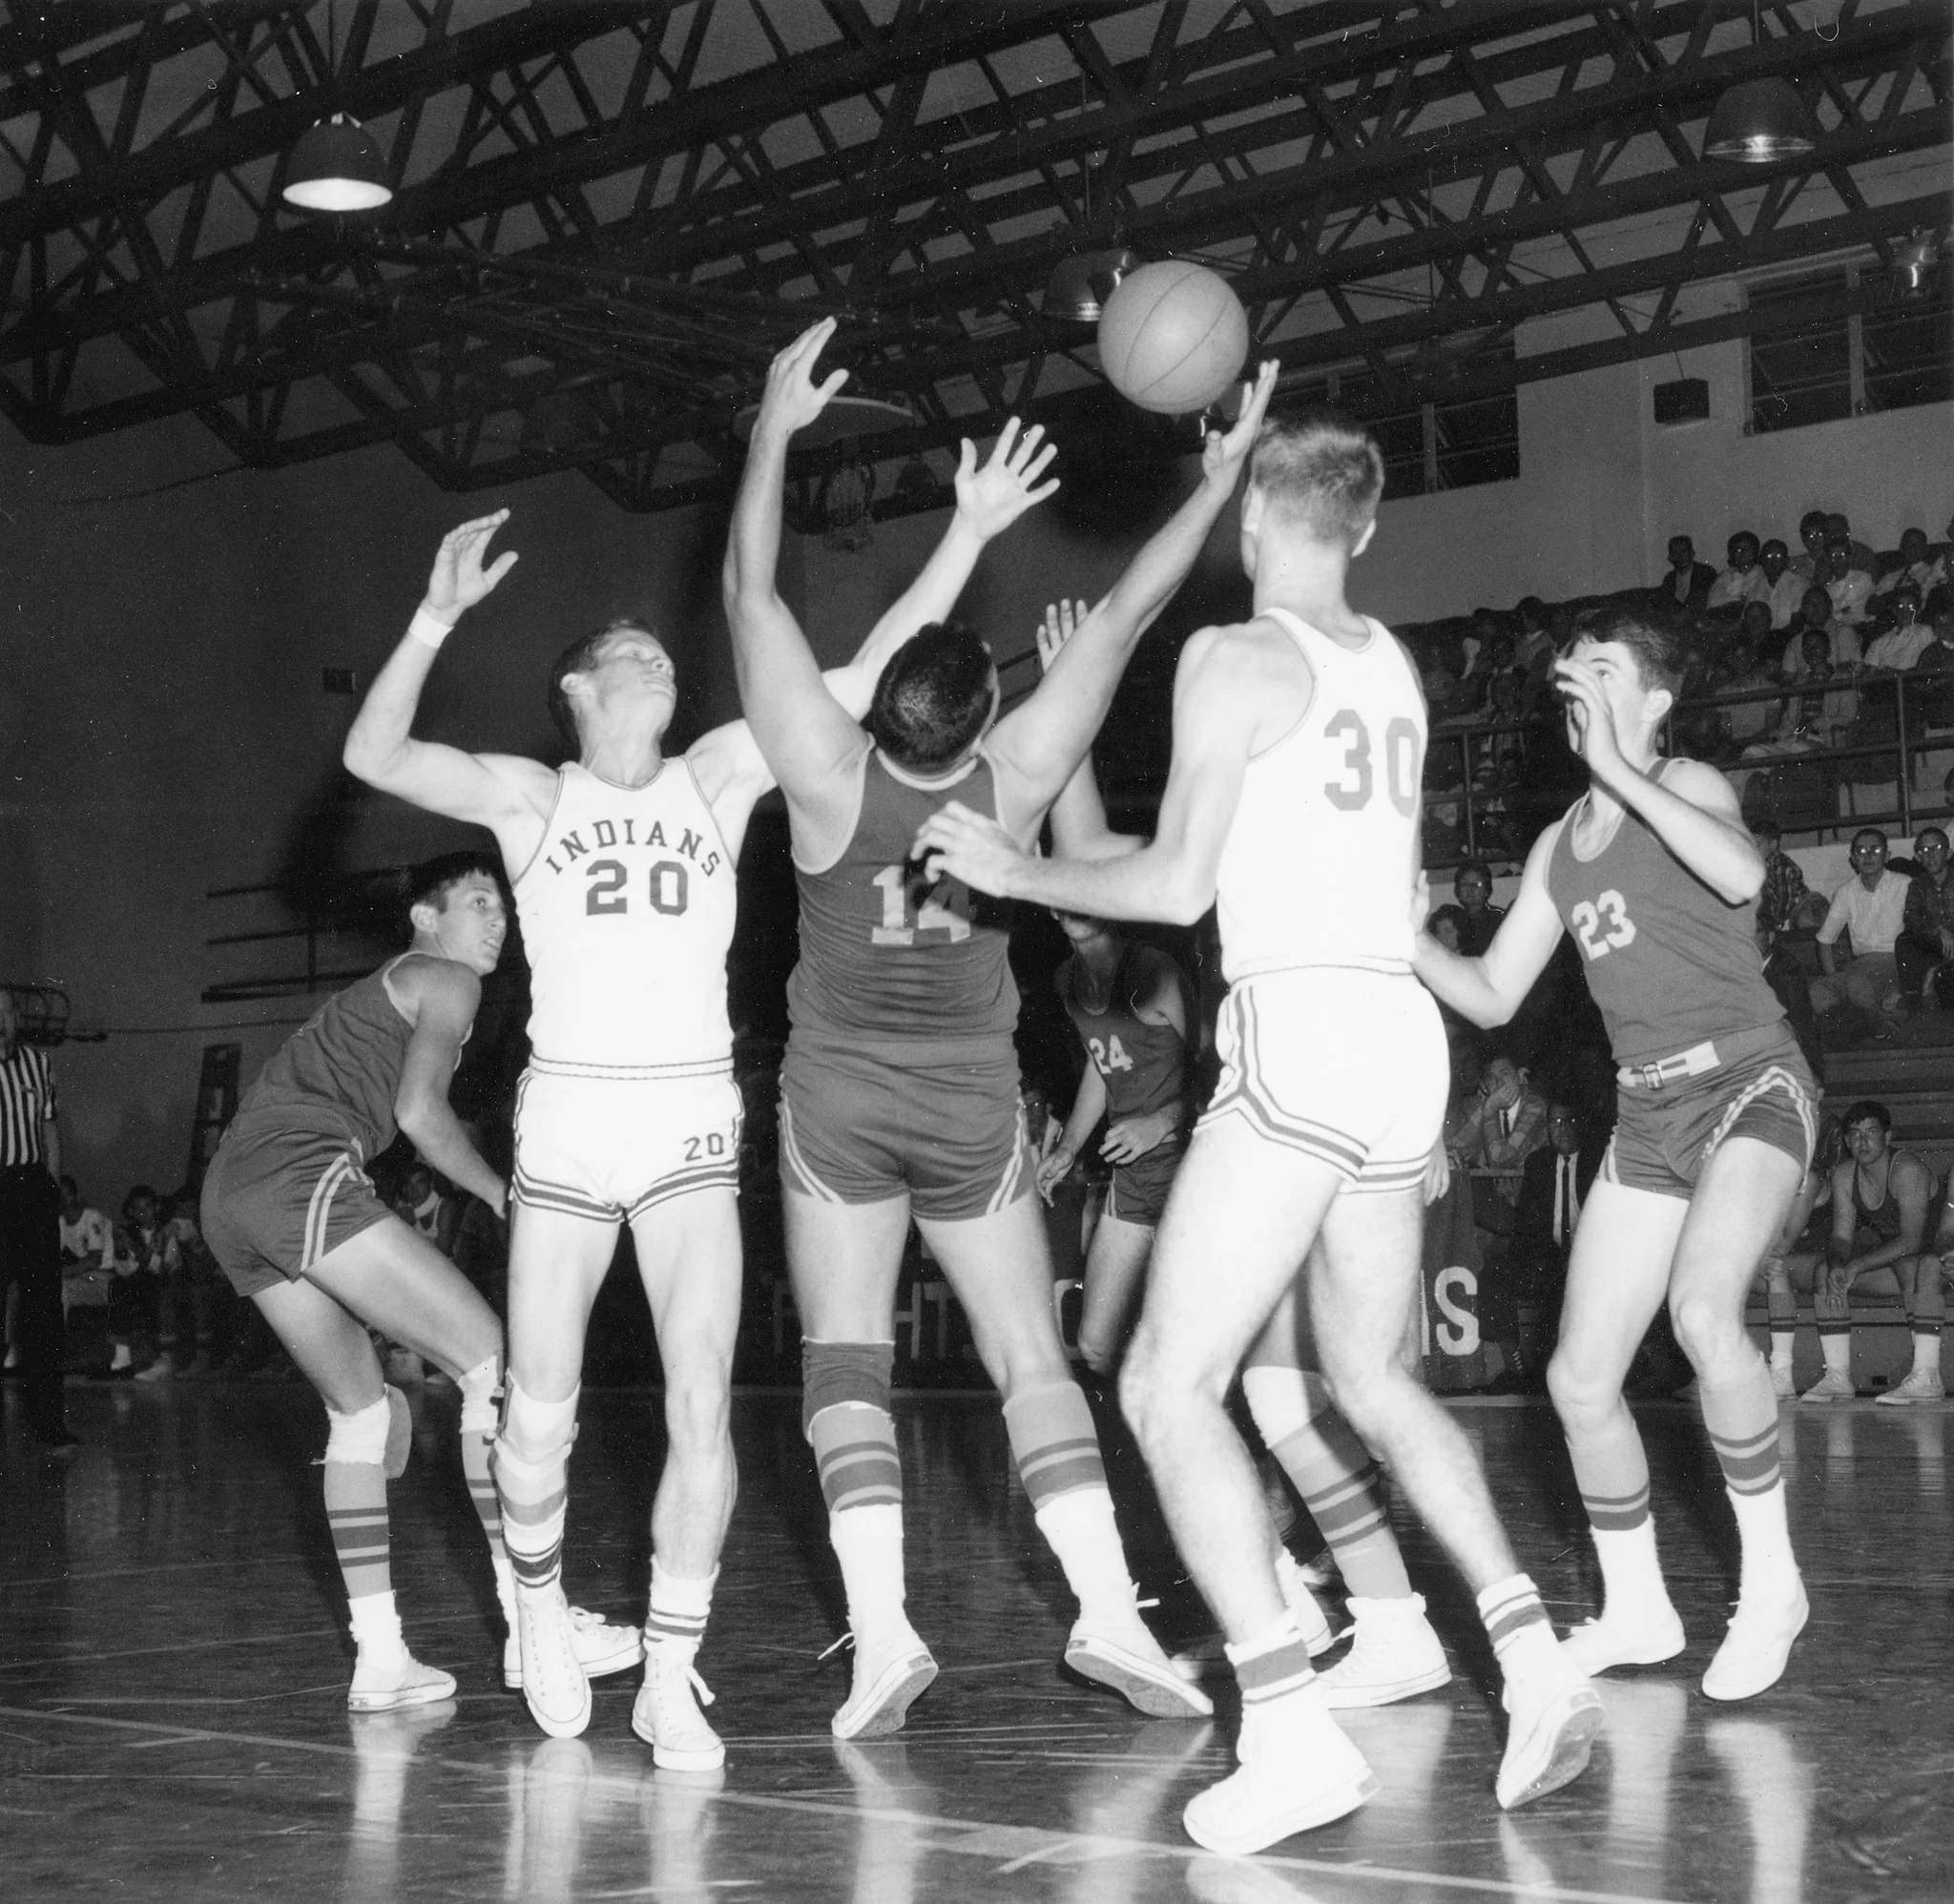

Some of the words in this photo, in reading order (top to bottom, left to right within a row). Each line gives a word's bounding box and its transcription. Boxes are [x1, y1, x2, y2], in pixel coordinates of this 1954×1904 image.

[1324, 709, 1421, 817] 30
[545, 818, 720, 878] INDIANS
[586, 859, 689, 916] 20
[871, 864, 971, 945] 14
[1571, 889, 1636, 962] 23
[1089, 1033, 1133, 1075] 24
[683, 1132, 725, 1162] 20
